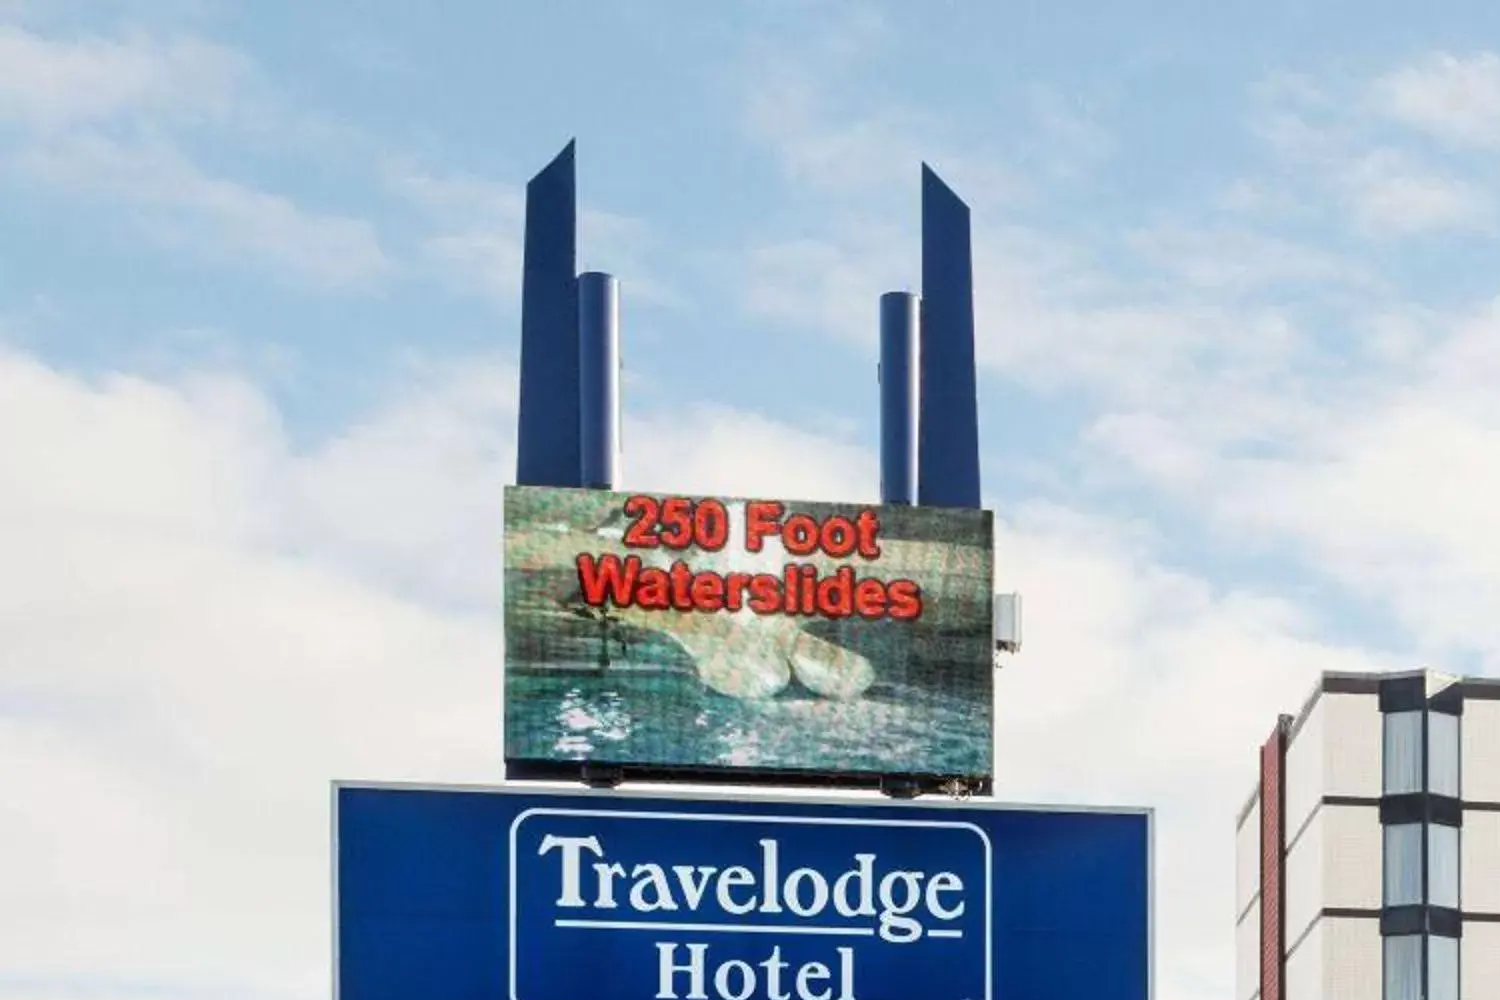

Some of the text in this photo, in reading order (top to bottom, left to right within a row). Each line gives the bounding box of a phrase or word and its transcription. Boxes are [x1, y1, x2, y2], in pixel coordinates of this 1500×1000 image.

[627, 497, 878, 558] 250 Foot
[579, 554, 920, 618] Waterslides
[538, 833, 965, 943] Travelodge
